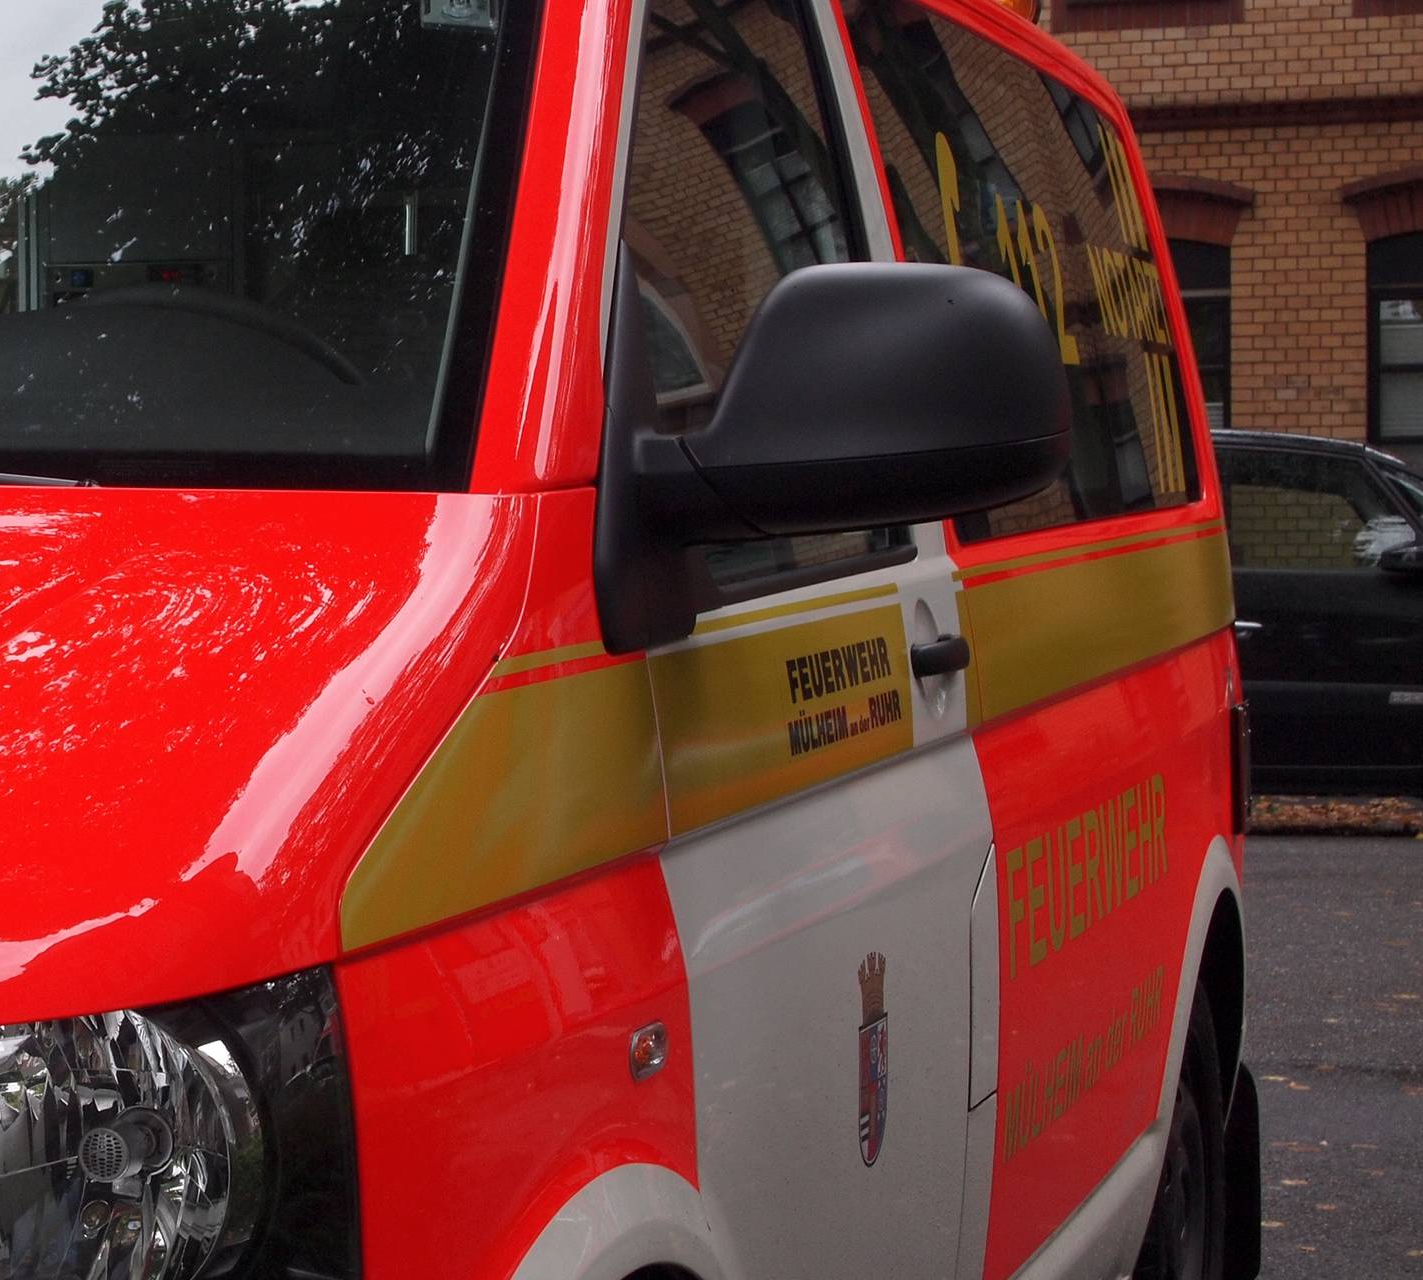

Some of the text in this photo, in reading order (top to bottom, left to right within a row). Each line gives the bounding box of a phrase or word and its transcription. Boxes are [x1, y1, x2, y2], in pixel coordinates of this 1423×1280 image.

[995, 192, 1080, 366] 112
[1087, 244, 1172, 346] NOTARZT
[785, 637, 892, 704] FEUERWEHR
[787, 705, 849, 756] MÜLHEIM
[859, 715, 870, 733] der
[868, 690, 902, 729] RUHR
[1006, 773, 1168, 980] FEUERWEHR
[1004, 965, 1165, 1162] MÜLHEIM an der RUHR
